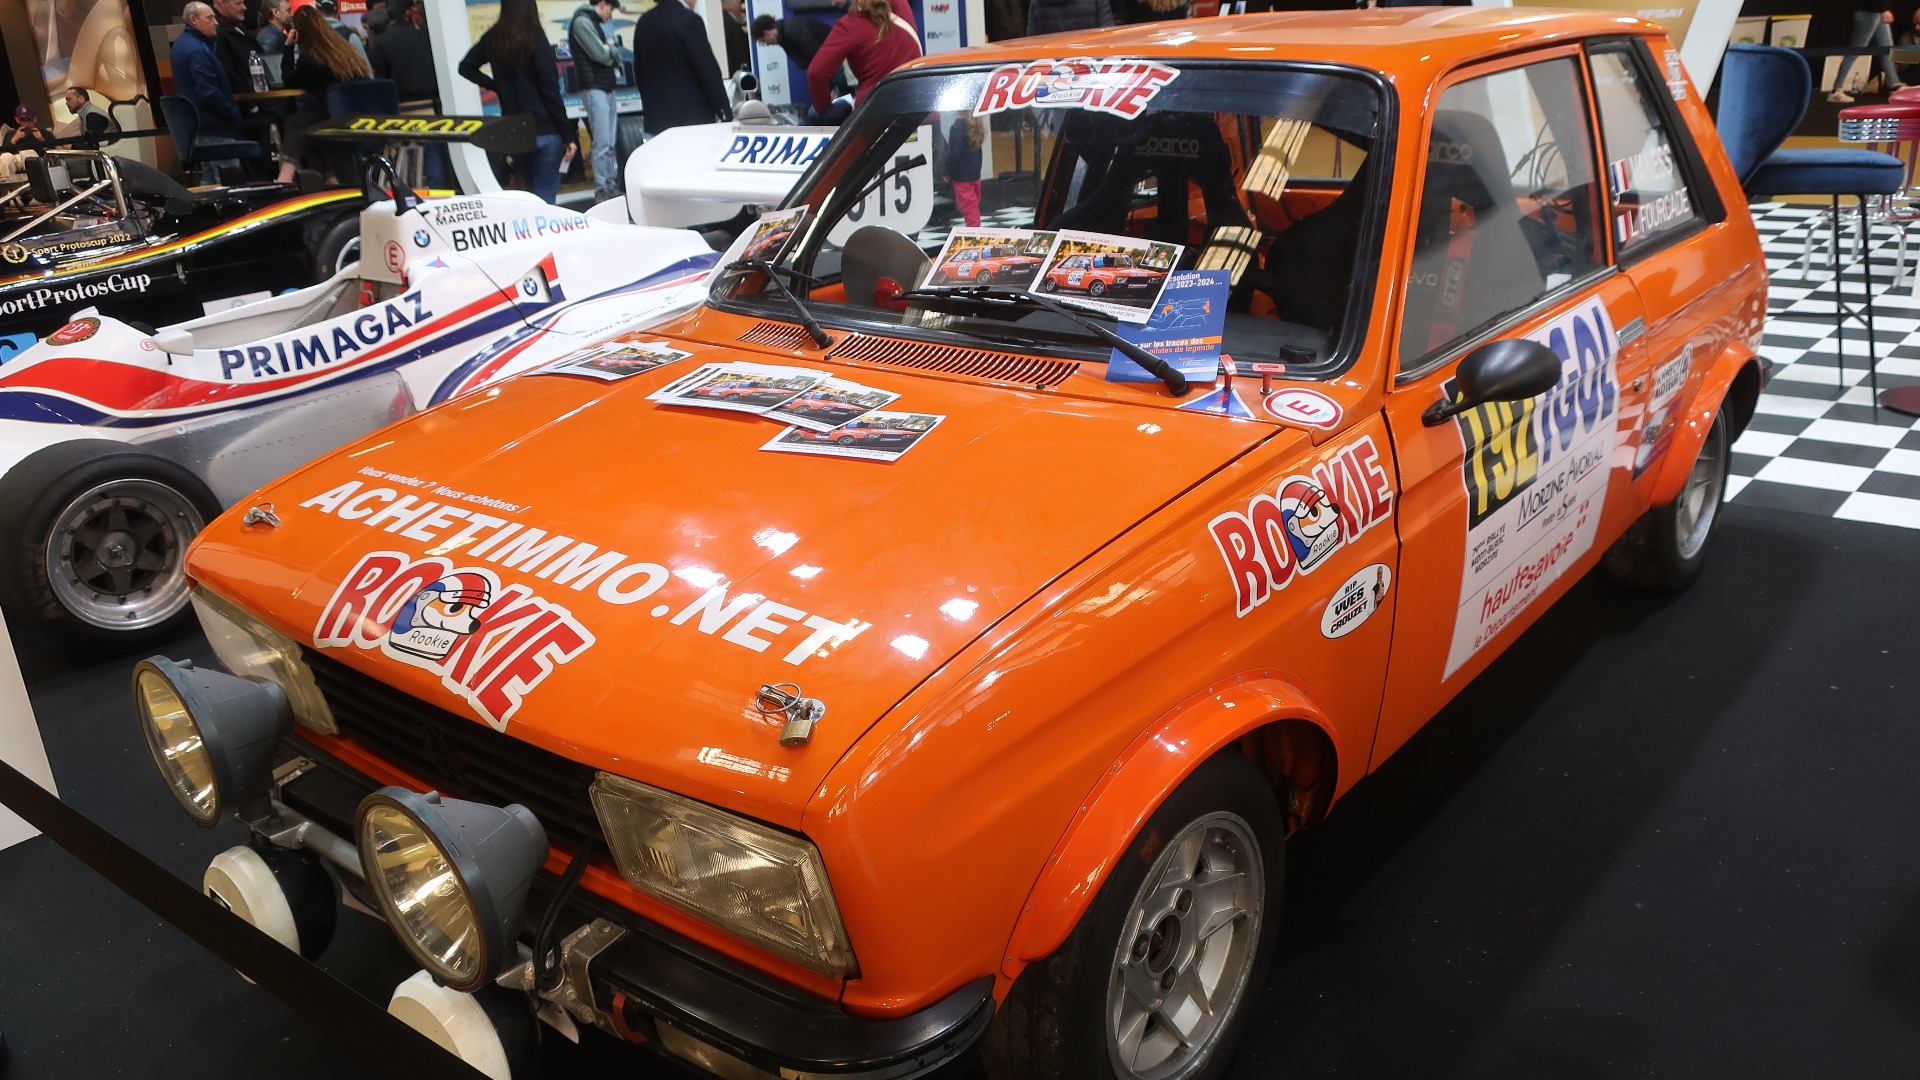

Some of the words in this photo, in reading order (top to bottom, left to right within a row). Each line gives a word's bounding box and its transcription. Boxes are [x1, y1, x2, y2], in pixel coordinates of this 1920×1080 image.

[846, 154, 913, 222] 15
[434, 200, 484, 215] TARRES
[436, 210, 488, 226] MARCEL
[31, 241, 59, 256] Sport
[59, 237, 108, 252] Protoscup
[109, 233, 132, 245] 2022
[452, 222, 507, 252] BMW
[512, 218, 532, 241] M
[534, 213, 591, 237] Power
[219, 290, 434, 380] PRIMAGAZ
[357, 465, 385, 479] Vous
[385, 471, 424, 489] vendez
[431, 485, 462, 500] Nous
[462, 491, 517, 512] achetons
[1313, 529, 1339, 557] Rookie
[299, 480, 866, 666] ACHETIMMO.NET
[1344, 580, 1358, 594] RIP
[1330, 600, 1370, 634] CROUZET
[408, 629, 451, 650] Rookie
